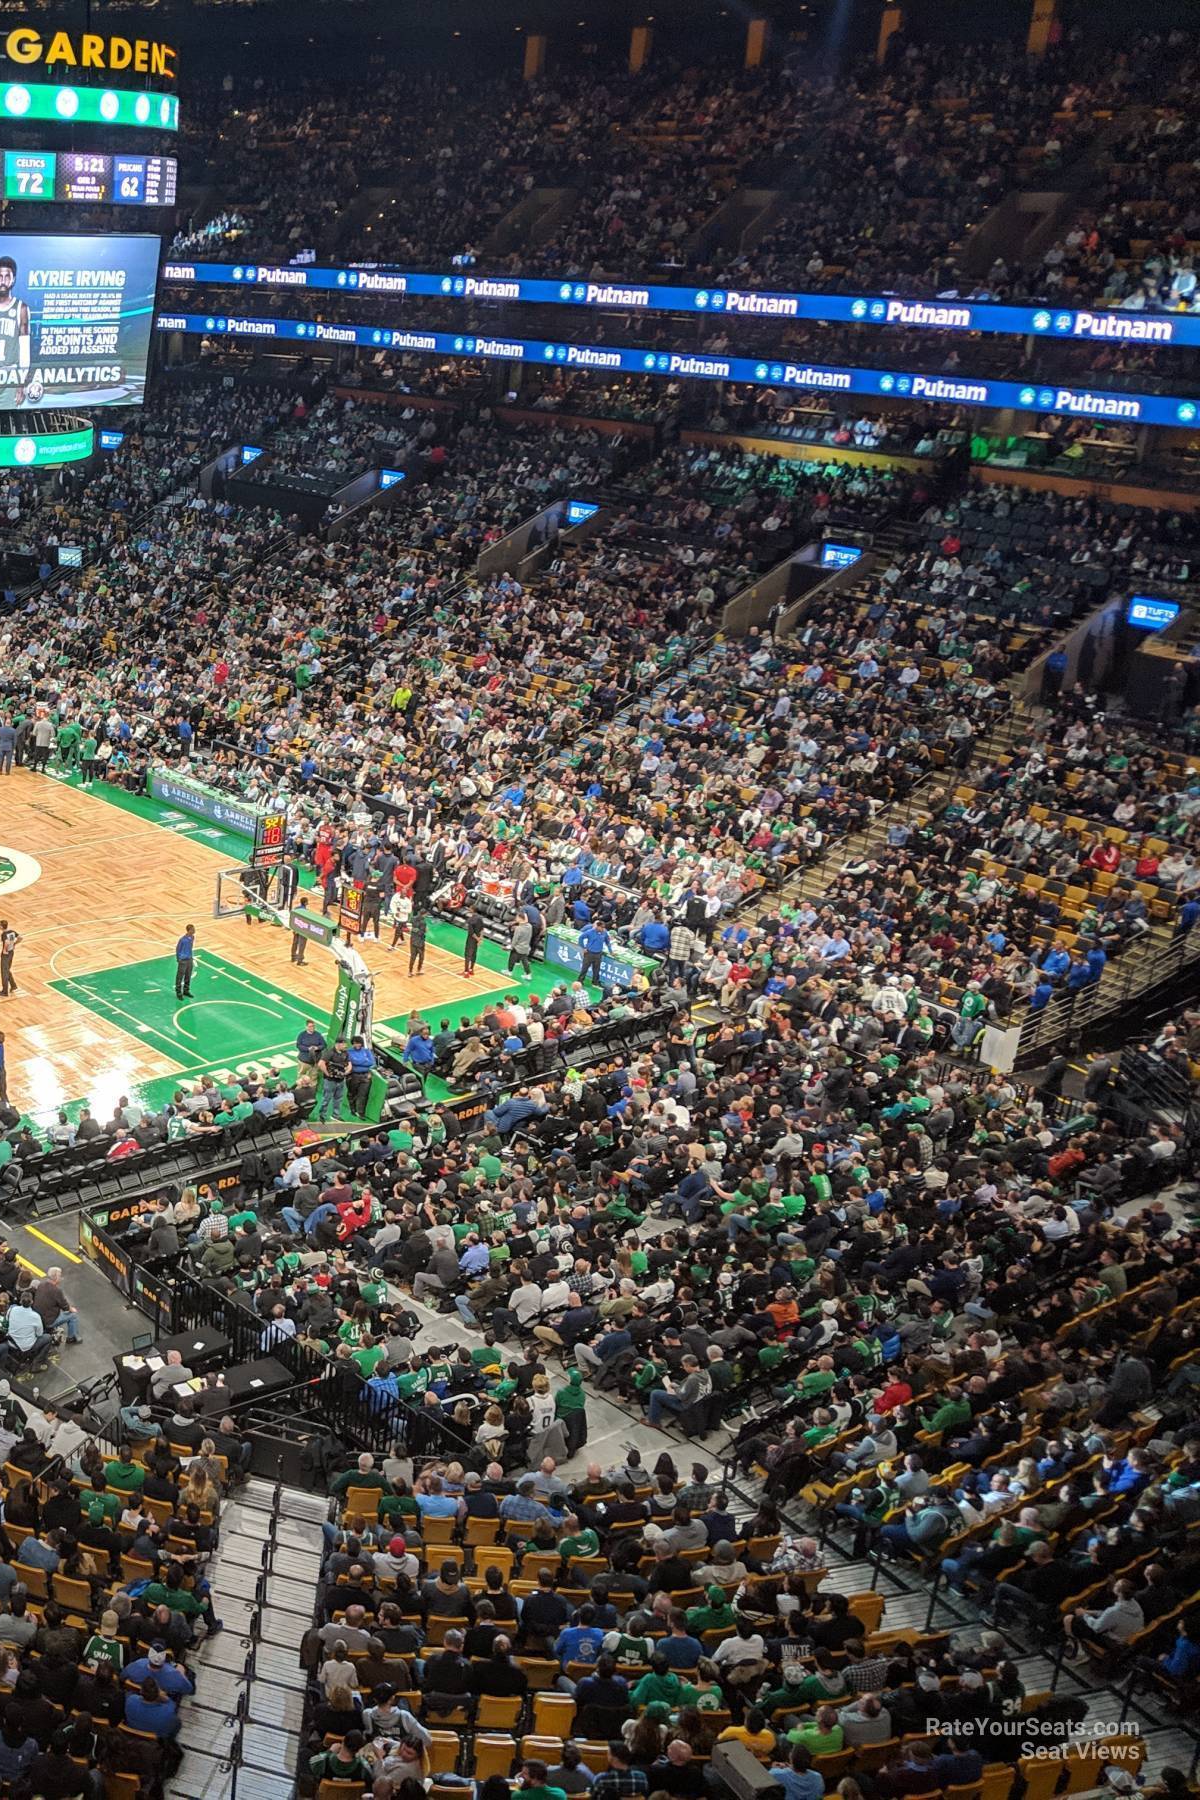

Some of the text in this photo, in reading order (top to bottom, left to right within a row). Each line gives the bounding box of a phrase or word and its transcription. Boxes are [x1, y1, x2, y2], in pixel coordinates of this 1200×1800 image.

[6, 28, 167, 75] GARDEN
[16, 158, 45, 168] CELTICS
[74, 157, 105, 173] 5:21
[16, 173, 43, 194] 72
[121, 177, 138, 197] 62
[28, 270, 126, 287] KYRIE IRVING
[165, 266, 195, 280] nam
[257, 267, 307, 284] Putnam
[358, 273, 406, 291] Putnam
[465, 278, 520, 298] Putnam
[587, 285, 649, 305] Putnam
[725, 292, 798, 315] Putnam
[887, 302, 970, 326] Putnam
[83, 326, 92, 334] HE
[93, 326, 119, 334] SCORED
[227, 319, 276, 335] Putnam
[316, 325, 356, 342] Putnam
[1074, 313, 1173, 341] Putnam
[41, 334, 118, 346] 26 POINTS AND
[392, 332, 436, 350] Putnam
[475, 339, 523, 357] Putnam
[40, 345, 117, 355] ADDED 10 ASSISTS.
[567, 347, 621, 367] Putnam
[32, 367, 121, 384] ANALYTICS
[670, 356, 730, 377] Putnam
[784, 365, 851, 388] Putnam
[912, 378, 988, 402] Putnam
[1055, 391, 1141, 417] Putnam
[1148, 607, 1177, 619] TUFTS
[171, 787, 205, 807] ARBELLA
[265, 817, 284, 829] 5:21
[573, 951, 630, 980] AELLA
[335, 984, 348, 1021] xfinity
[346, 1011, 356, 1040] Putnam
[454, 1103, 488, 1121] ARDEN
[97, 1200, 159, 1224] TD GARDE
[92, 1235, 128, 1276] GARDEN
[543, 1415, 551, 1429] 0
[244, 1603, 254, 1612] 5
[240, 1639, 251, 1649] 6
[780, 1644, 811, 1658] WHITE
[93, 1650, 112, 1662] SMART
